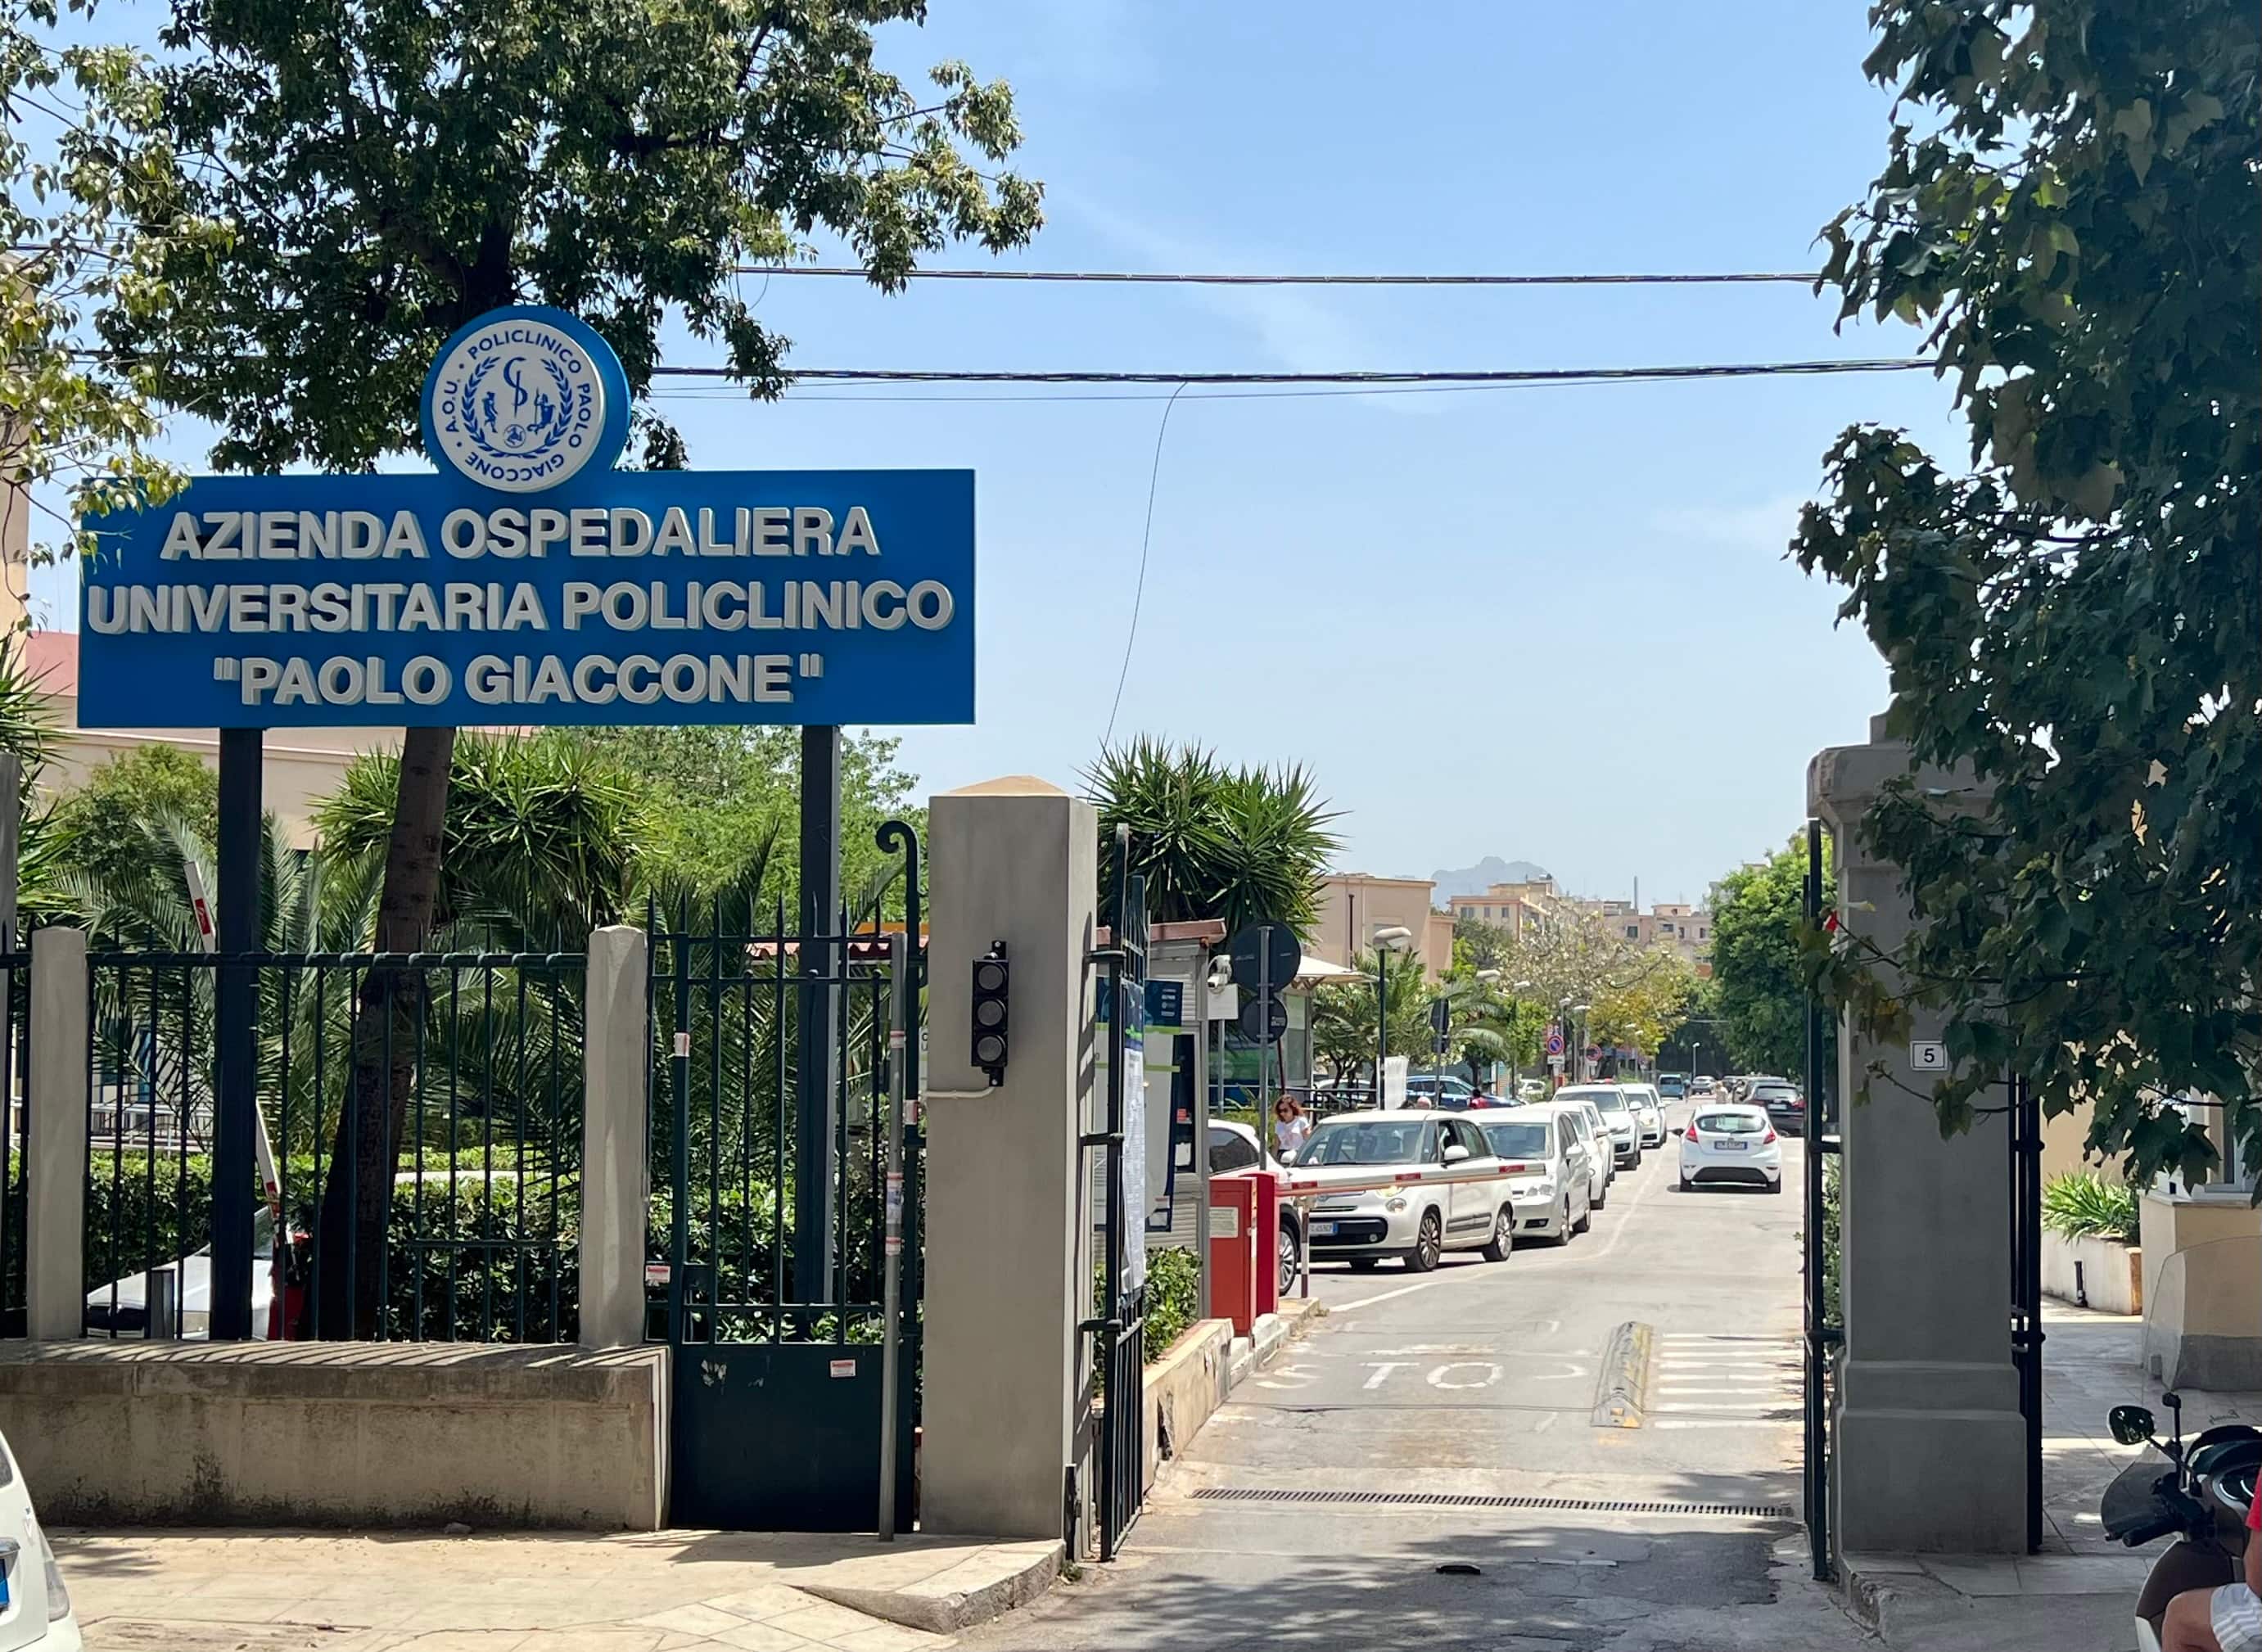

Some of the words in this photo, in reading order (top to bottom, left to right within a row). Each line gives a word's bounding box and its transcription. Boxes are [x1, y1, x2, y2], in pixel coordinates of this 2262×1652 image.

[467, 330, 581, 373] POLICLINICO
[568, 382, 592, 449] PAOLO
[465, 451, 565, 481] GIACCONE
[160, 511, 431, 561] AZIENDA
[441, 506, 882, 558] OSPEDALIERA
[87, 582, 549, 634] UNIVERSITARIA
[563, 580, 955, 632] POLICLINICO
[213, 656, 452, 706] "PAOLO
[465, 652, 824, 705] GIACCONE"
[1923, 1047, 1935, 1063] 5
